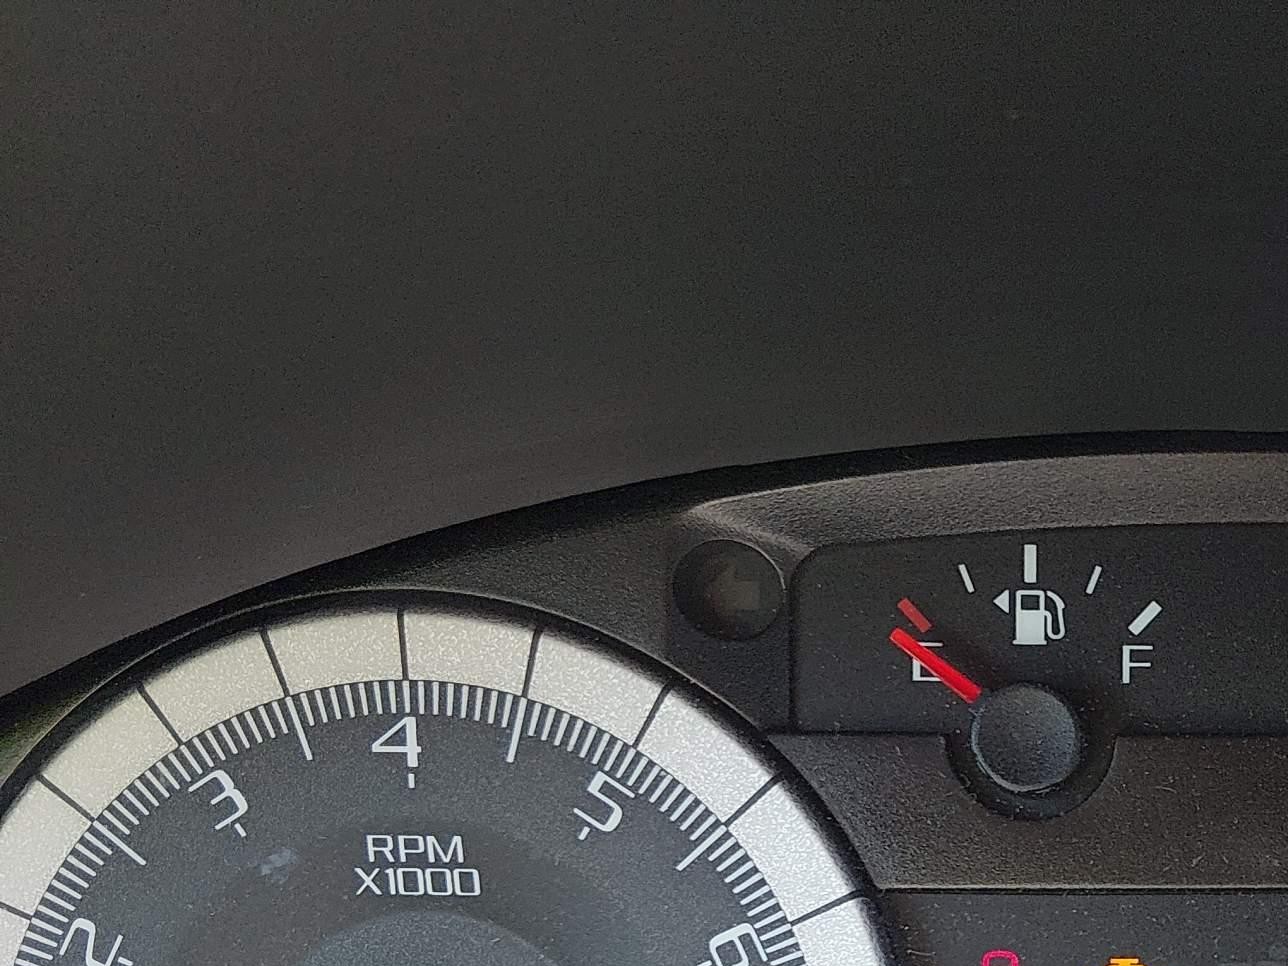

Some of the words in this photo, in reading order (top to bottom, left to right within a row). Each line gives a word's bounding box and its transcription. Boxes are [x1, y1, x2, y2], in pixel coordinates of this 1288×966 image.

[1121, 645, 1153, 684] F
[371, 716, 423, 767] 4
[188, 770, 250, 831] 3
[573, 772, 636, 833] 5
[366, 835, 465, 864] RPM
[354, 867, 482, 896] X1000
